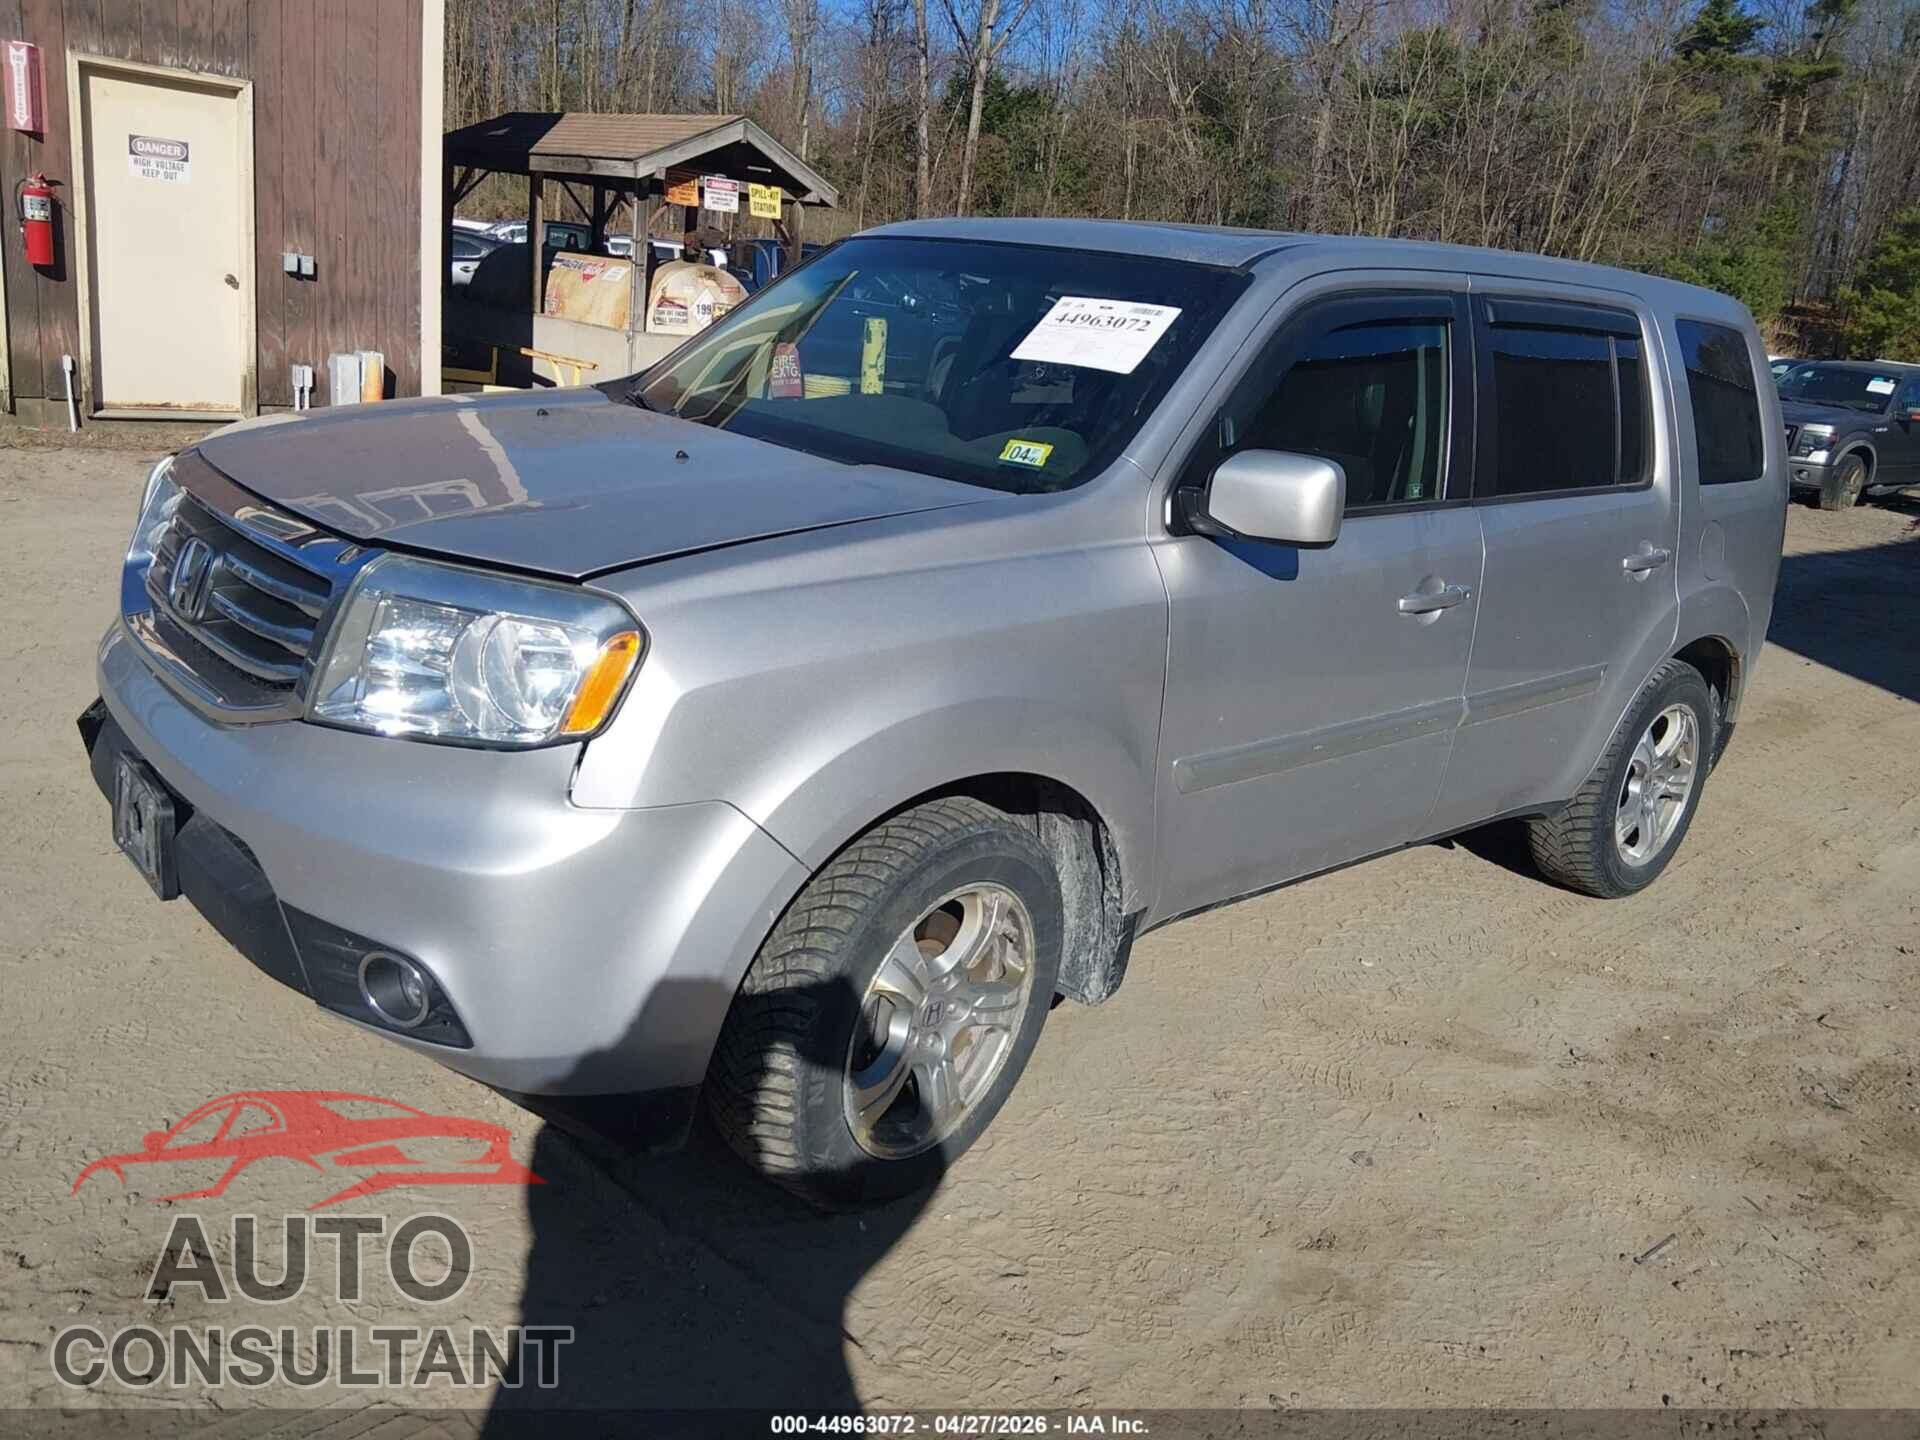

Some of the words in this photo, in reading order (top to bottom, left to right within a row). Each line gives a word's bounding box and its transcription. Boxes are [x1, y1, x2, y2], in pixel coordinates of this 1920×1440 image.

[137, 140, 181, 157] DANGER
[133, 157, 151, 168] HIGH
[156, 161, 185, 173] VOLTAGE
[142, 168, 160, 178] KEEP
[163, 171, 178, 181] OUT
[753, 201, 777, 214] STATION
[1055, 311, 1152, 333] 44963072
[772, 354, 796, 368] FIRE
[1009, 446, 1031, 461] 04
